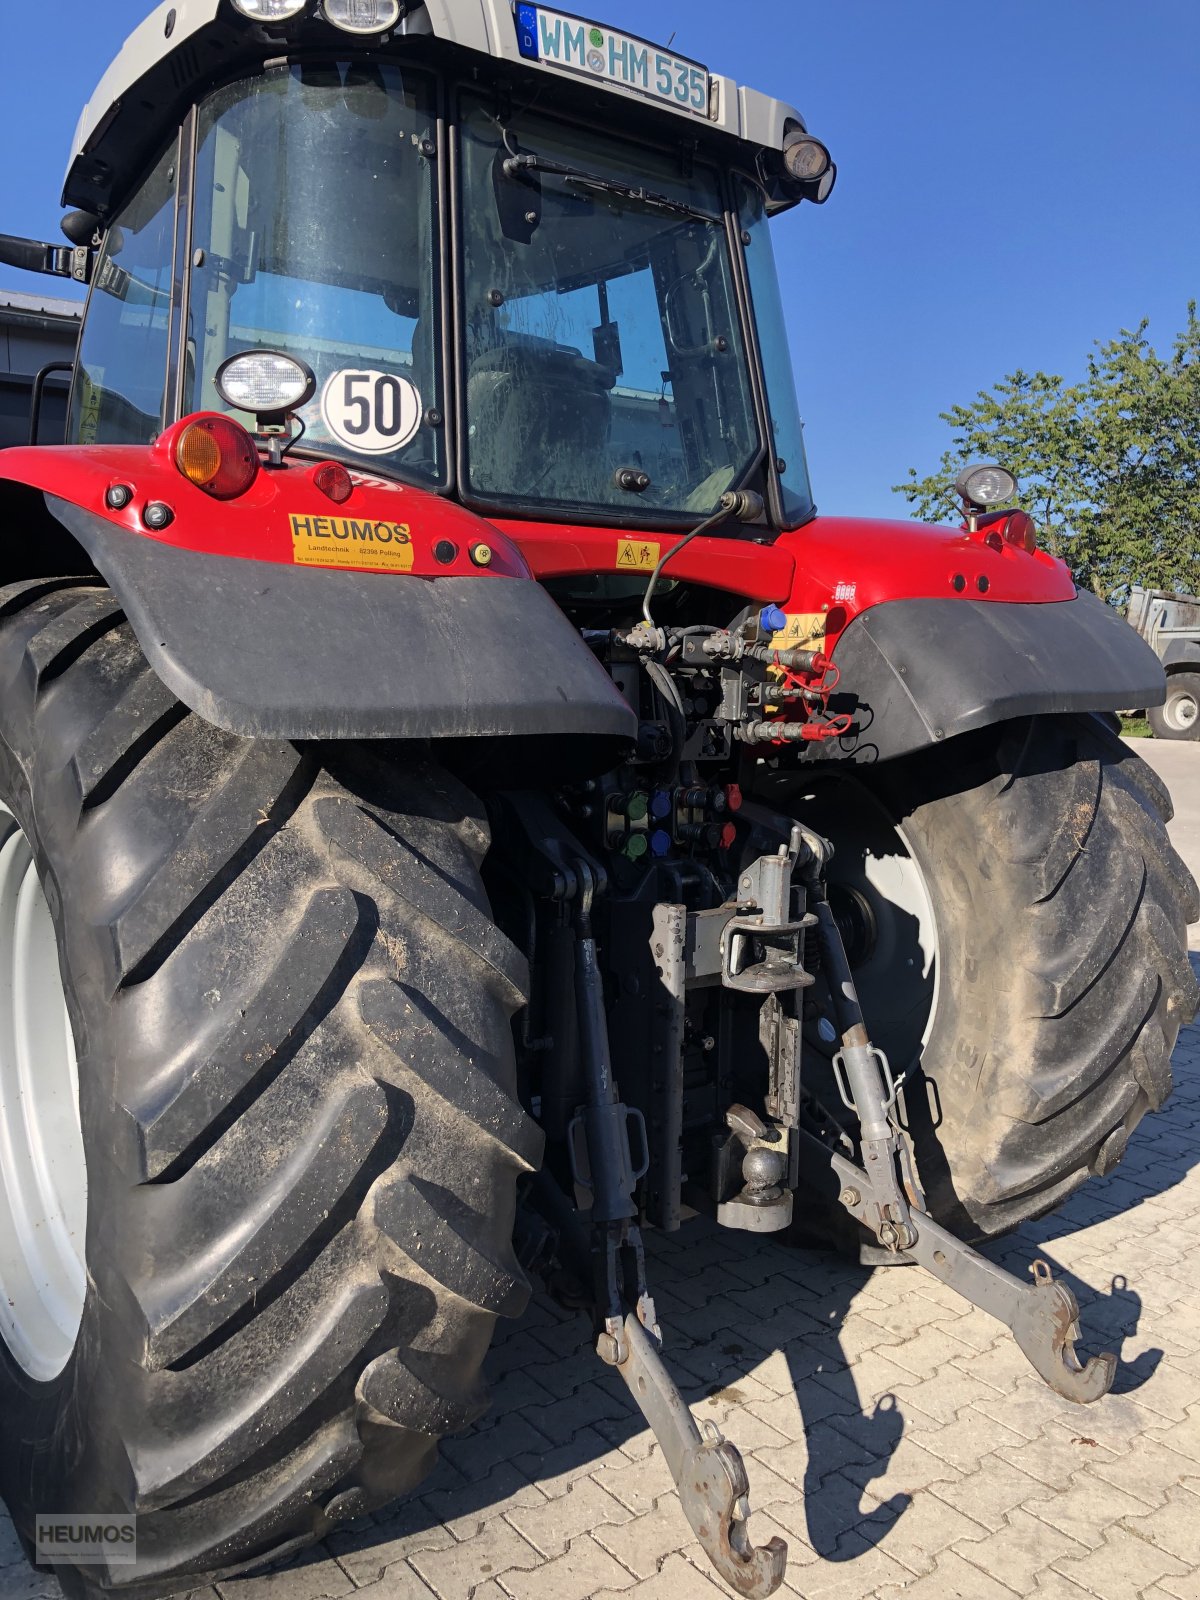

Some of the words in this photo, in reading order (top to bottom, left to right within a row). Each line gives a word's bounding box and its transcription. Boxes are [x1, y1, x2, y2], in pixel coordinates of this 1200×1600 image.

[524, 35, 532, 47] D
[539, 15, 585, 66] WM
[608, 36, 648, 88] HM
[655, 54, 705, 109] 535
[343, 374, 401, 436] 50
[291, 516, 411, 544] HEUMOS
[308, 544, 350, 553] Landtechnik
[379, 549, 401, 557] Polling
